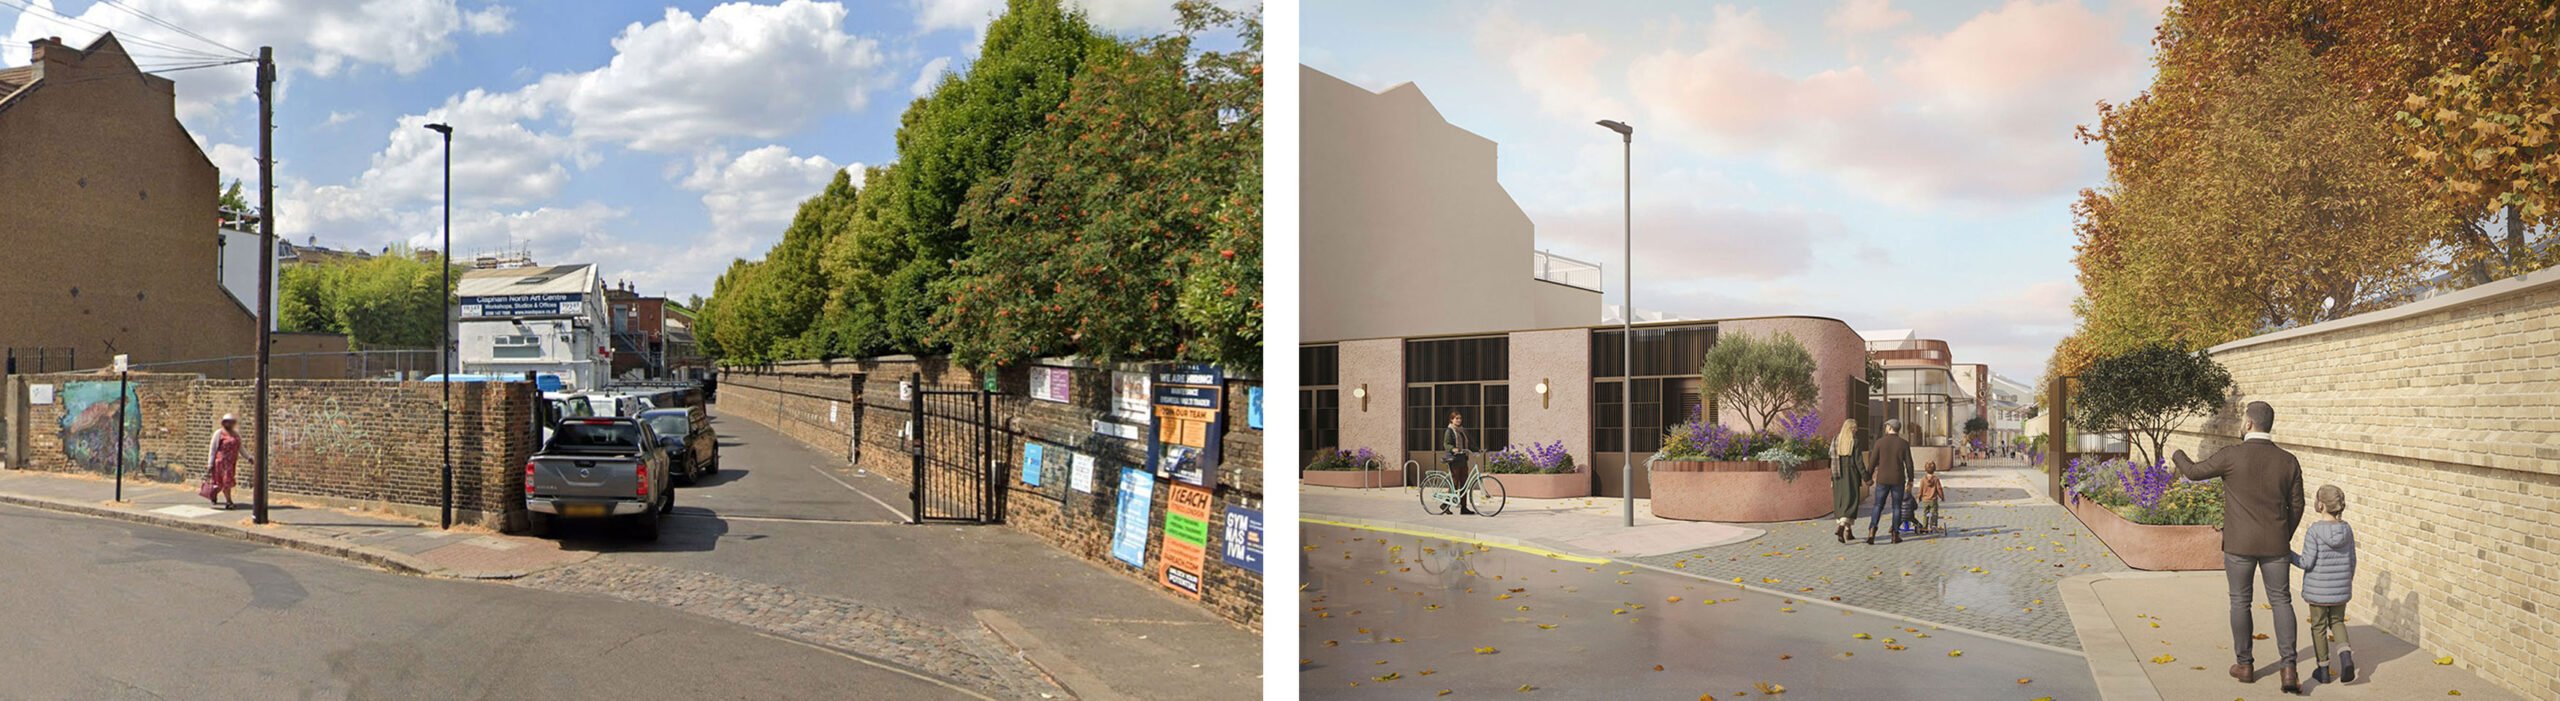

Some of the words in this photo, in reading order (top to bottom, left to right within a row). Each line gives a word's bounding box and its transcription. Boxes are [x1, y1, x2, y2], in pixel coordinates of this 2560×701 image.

[1159, 373, 1170, 382] WE
[1171, 373, 1185, 383] ARE
[1175, 408, 1188, 417] OUR
[1227, 512, 1248, 531] GYM
[1225, 527, 1245, 545] NAS
[1227, 542, 1245, 560] IVM
